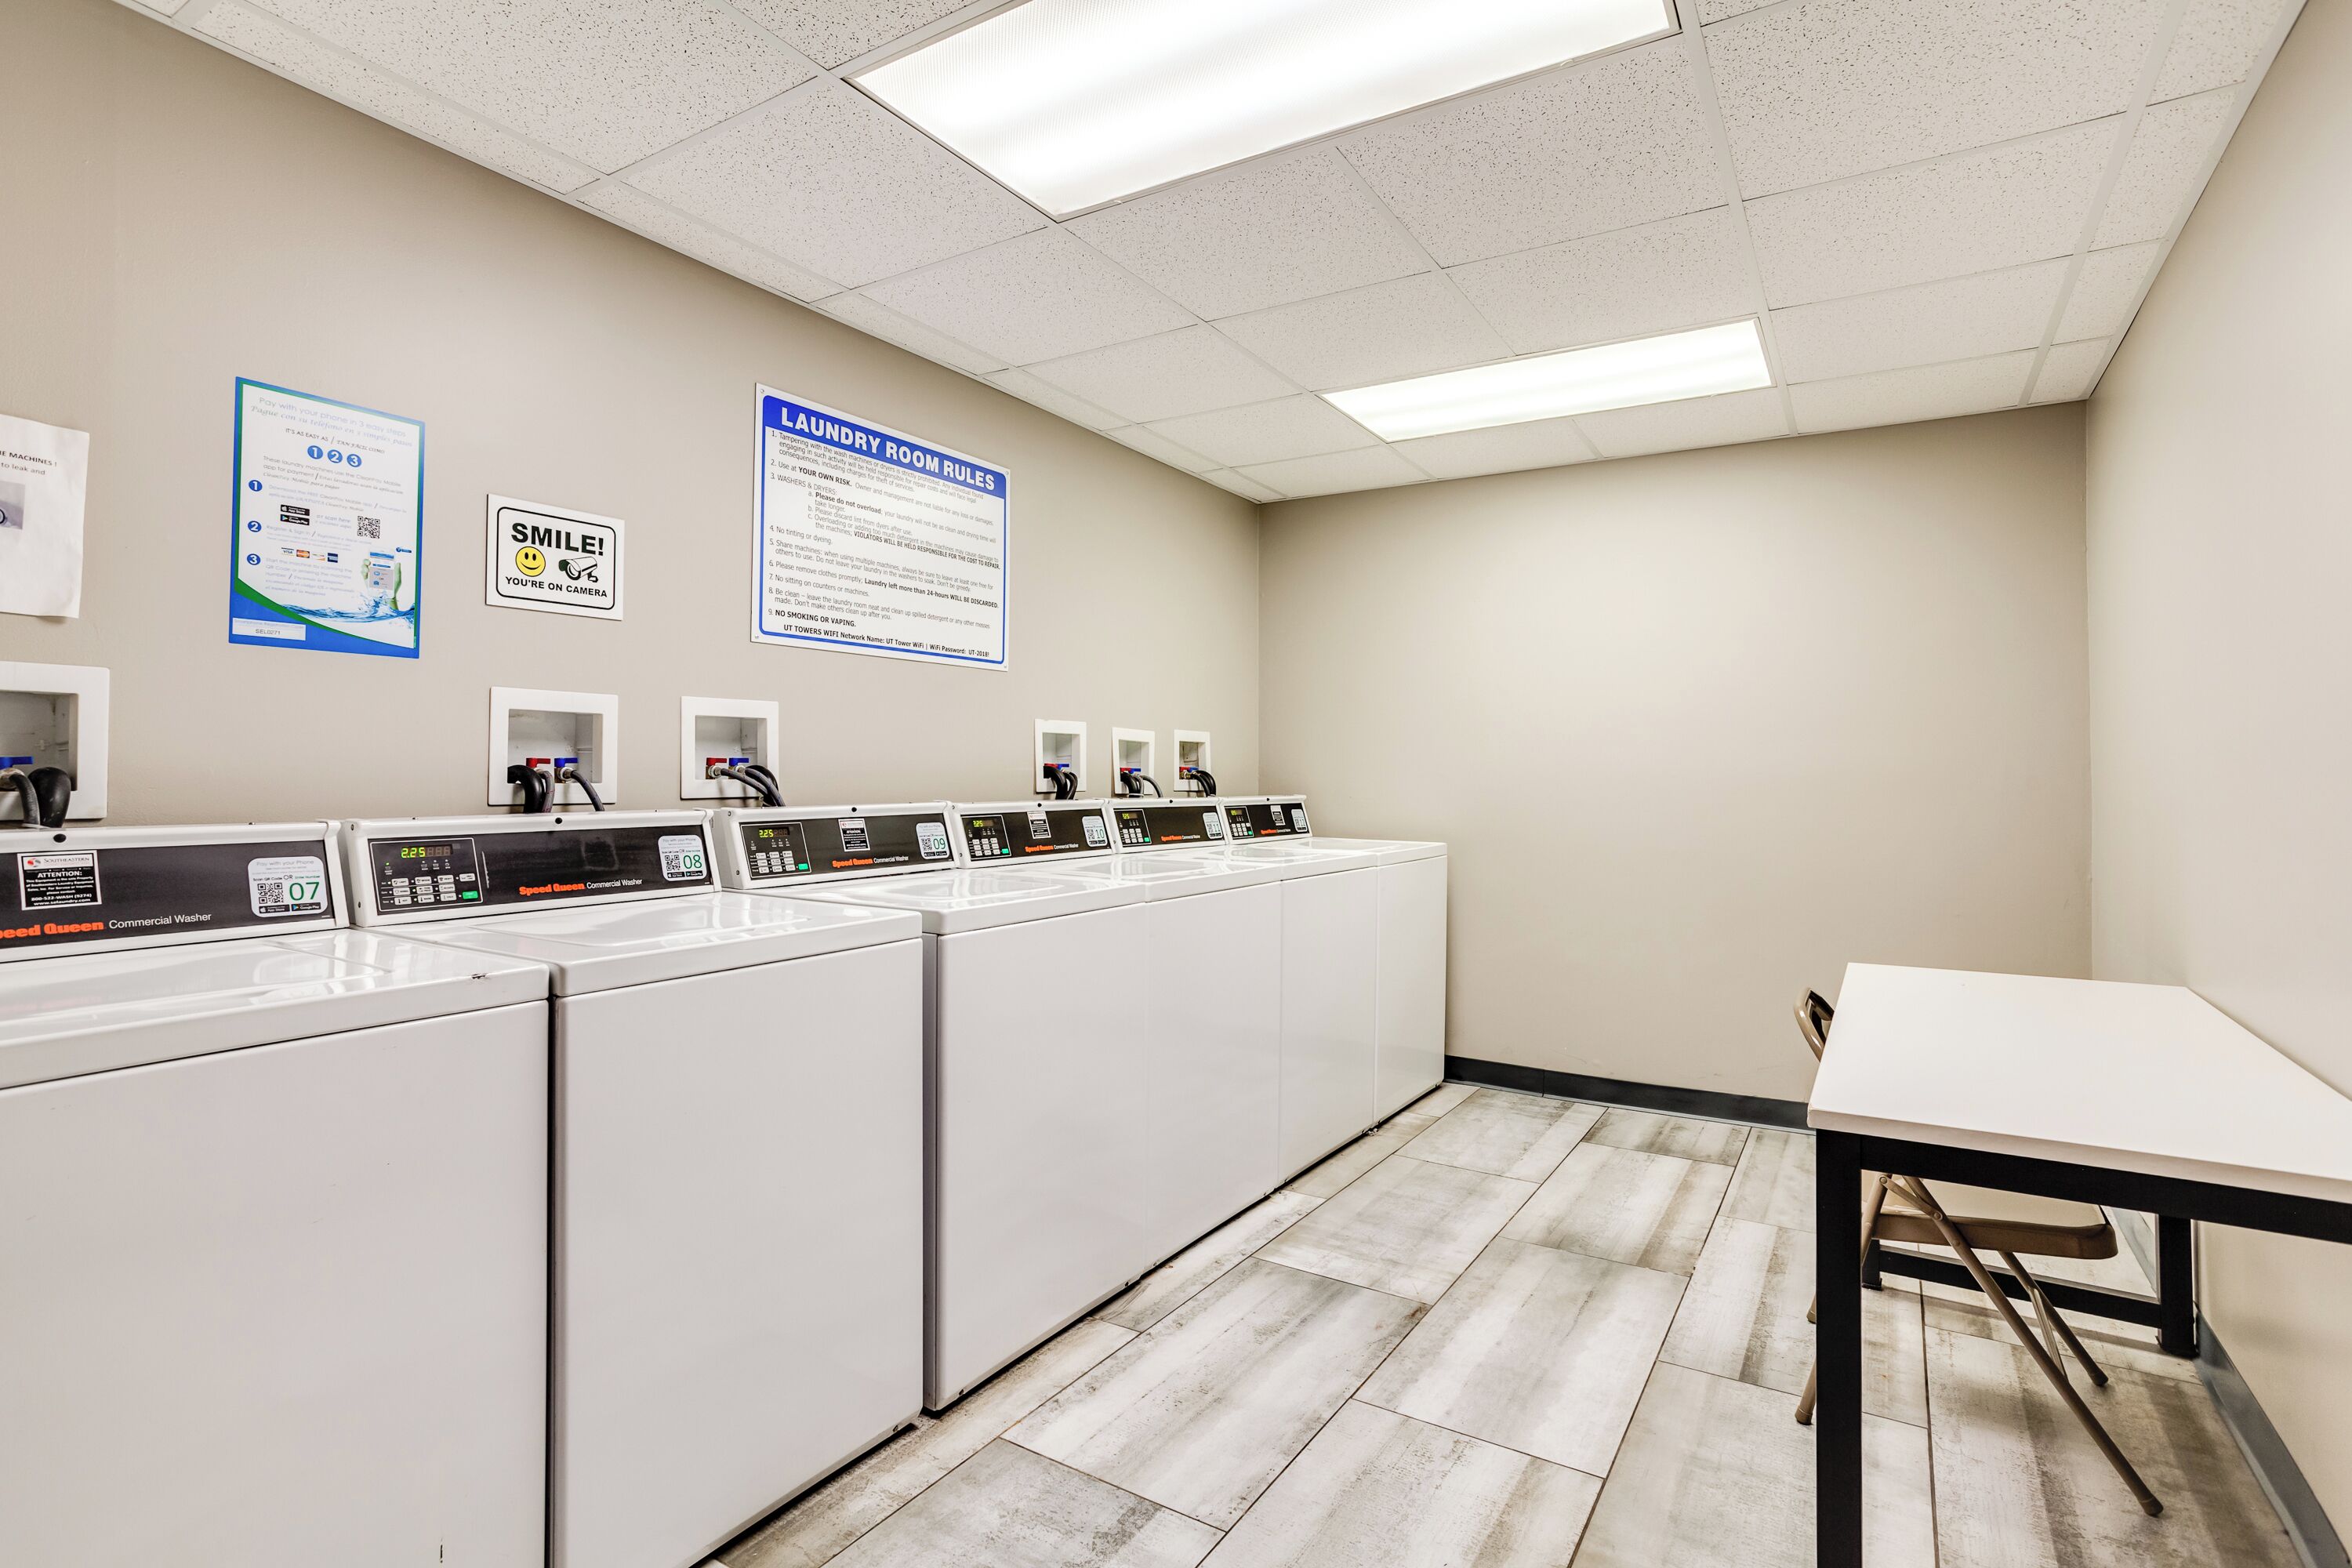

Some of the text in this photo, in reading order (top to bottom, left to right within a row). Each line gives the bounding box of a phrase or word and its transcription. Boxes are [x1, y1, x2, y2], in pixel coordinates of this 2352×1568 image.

[258, 397, 275, 408] Pay
[278, 401, 296, 412] with
[299, 408, 318, 419] your
[320, 411, 348, 425] phone
[358, 419, 365, 428] 3
[312, 446, 358, 466] 1 2 3
[778, 432, 808, 448] Tampering
[809, 441, 822, 452] with
[822, 445, 833, 455] the
[833, 448, 848, 459] wash
[848, 453, 872, 466] machines
[880, 463, 895, 474] dryers
[781, 405, 994, 491] LAUNDRY ROOM RULES
[9, 452, 53, 466] MACHINES
[12, 463, 28, 472] leak
[778, 460, 789, 470] Use
[790, 463, 797, 472] at
[797, 466, 816, 477] YOUR
[818, 471, 833, 482] OWN
[835, 476, 851, 487] RISK.
[252, 481, 258, 490] 1
[776, 474, 839, 496] WASHERS DRYERS:
[815, 492, 835, 503] Please
[845, 499, 855, 508] not
[251, 521, 258, 531] 2
[511, 522, 604, 556] SMILE!
[249, 554, 257, 564] 3
[853, 530, 882, 543] VIOLATORS
[883, 537, 895, 546] WILL
[903, 542, 916, 550] HELD
[916, 545, 947, 557] RESPONSIBLE
[966, 556, 977, 564] COST
[984, 561, 1000, 569] REPAIR.
[505, 576, 608, 597] YOU'RE ON CAMERA
[775, 561, 794, 571] Please
[795, 565, 817, 575] remove
[817, 568, 837, 579] clothes
[864, 577, 887, 589] Laundry
[913, 586, 925, 595] than
[927, 589, 949, 599] 24-hours
[970, 597, 999, 608] DISCARDED.
[784, 575, 802, 586] sitting
[812, 580, 836, 591] counters
[844, 586, 869, 597] machines.
[775, 608, 786, 617] NO
[786, 611, 818, 622] SMOKING
[830, 617, 856, 627] VAPING.
[793, 625, 822, 635] TOWERS
[822, 629, 838, 637] WIFI
[840, 631, 865, 641] Network
[866, 635, 884, 644] Name:
[895, 638, 911, 647] Tower
[941, 645, 966, 654] Password:
[967, 648, 989, 657] UT-2018!
[1096, 829, 1105, 838] 10
[401, 847, 426, 858] 2.25
[933, 838, 946, 850] 09
[684, 855, 702, 869] 08
[833, 859, 853, 868] Speed
[853, 857, 873, 866] Queen
[289, 881, 320, 901] 07
[519, 884, 552, 895] Speed
[553, 883, 585, 891] Queen
[586, 880, 621, 889] Commercial
[44, 923, 104, 935] Queen
[109, 916, 172, 929] Commercial
[174, 913, 212, 923] Washer
